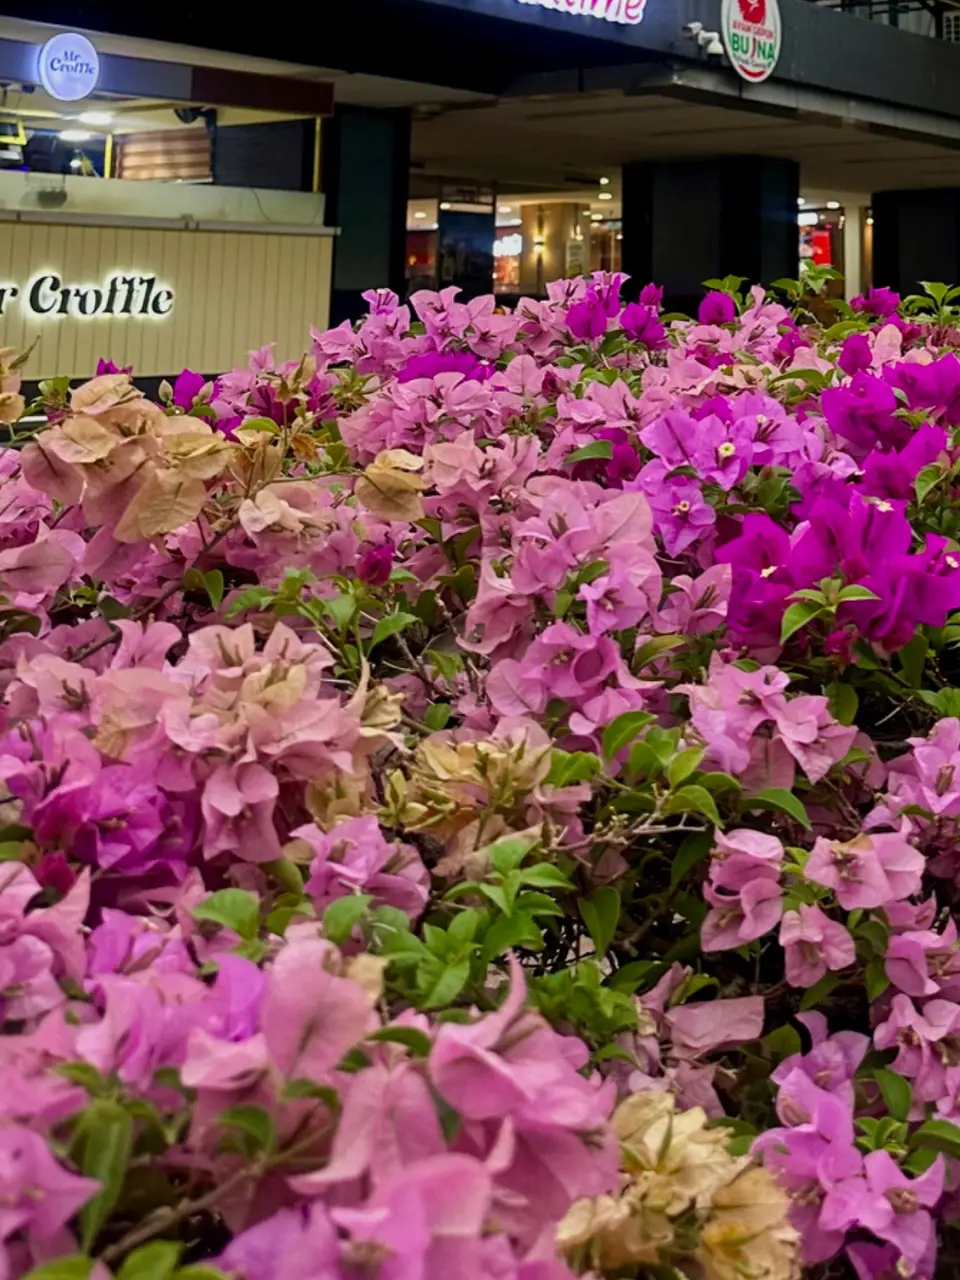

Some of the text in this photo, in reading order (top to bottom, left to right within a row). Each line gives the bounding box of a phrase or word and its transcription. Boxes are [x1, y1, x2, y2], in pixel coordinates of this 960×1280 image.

[64, 50, 82, 62] Mr
[50, 57, 95, 74] Croffle
[0, 275, 174, 315] r Croffle
